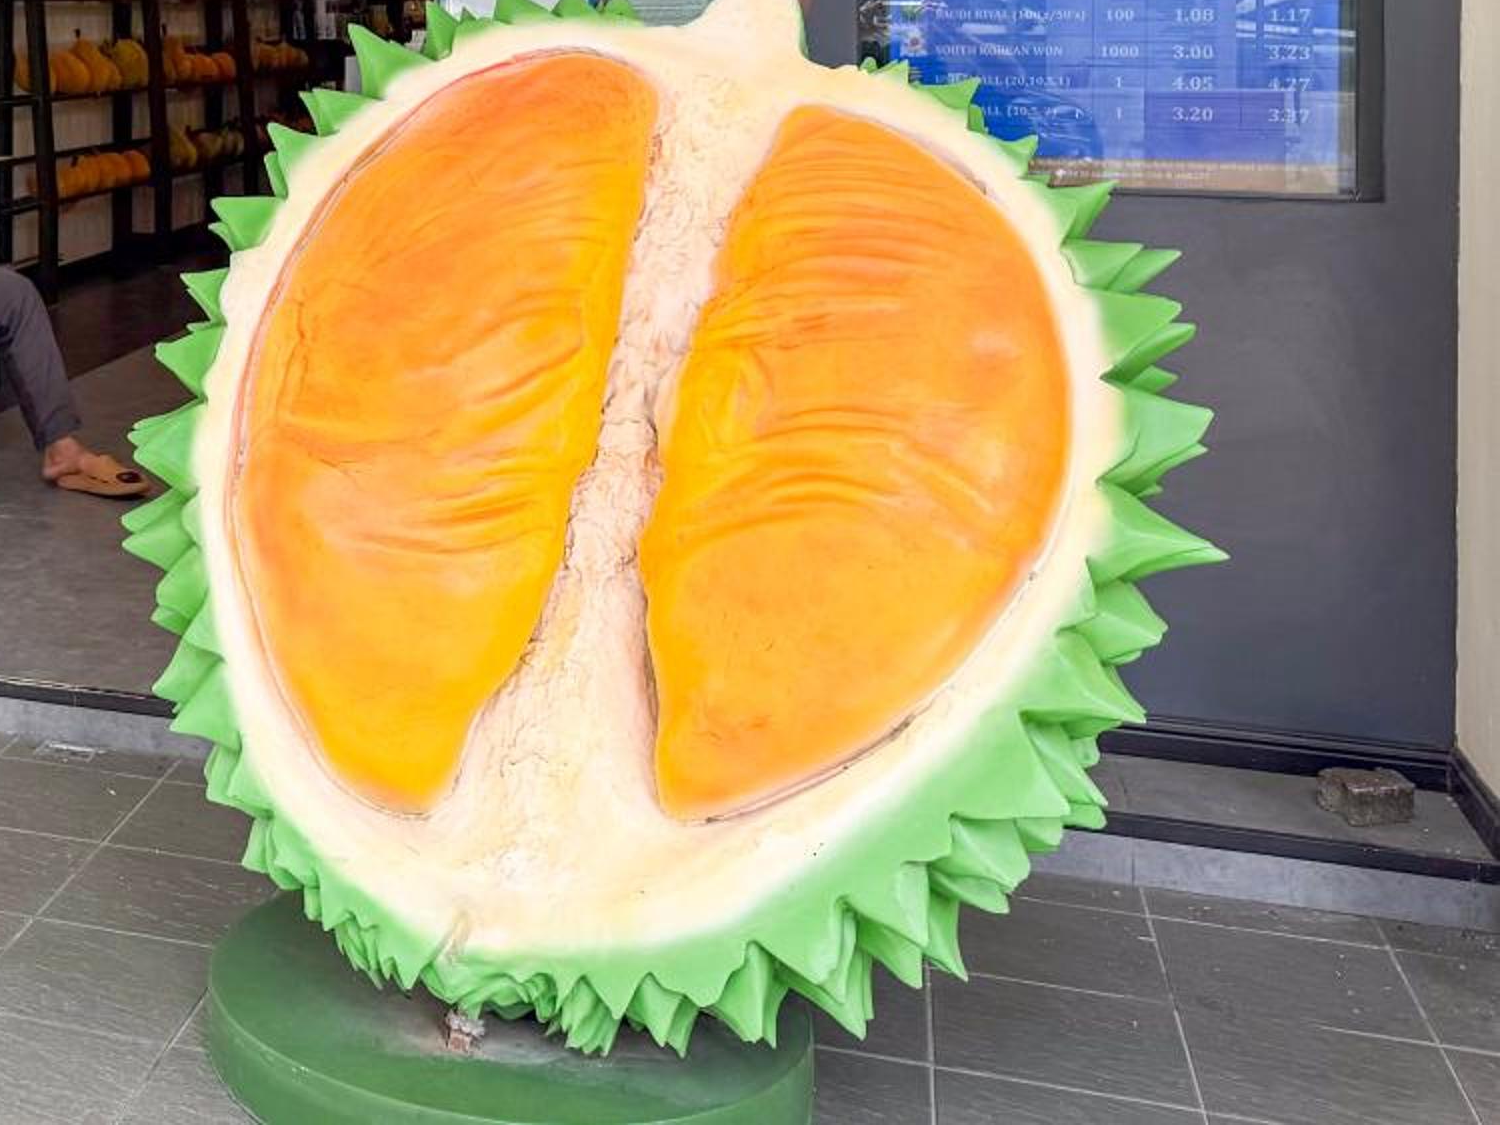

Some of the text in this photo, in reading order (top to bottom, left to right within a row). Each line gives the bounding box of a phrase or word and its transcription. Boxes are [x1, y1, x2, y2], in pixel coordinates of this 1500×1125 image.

[1106, 7, 1135, 22] 100
[1174, 7, 1215, 22] 1.08
[1269, 8, 1312, 23] 1.17
[1100, 44, 1140, 59] 1000
[1172, 44, 1215, 60] 3.00
[1268, 45, 1311, 60] 3.23
[1172, 75, 1214, 91] 4.05
[1172, 108, 1214, 123] 3.20
